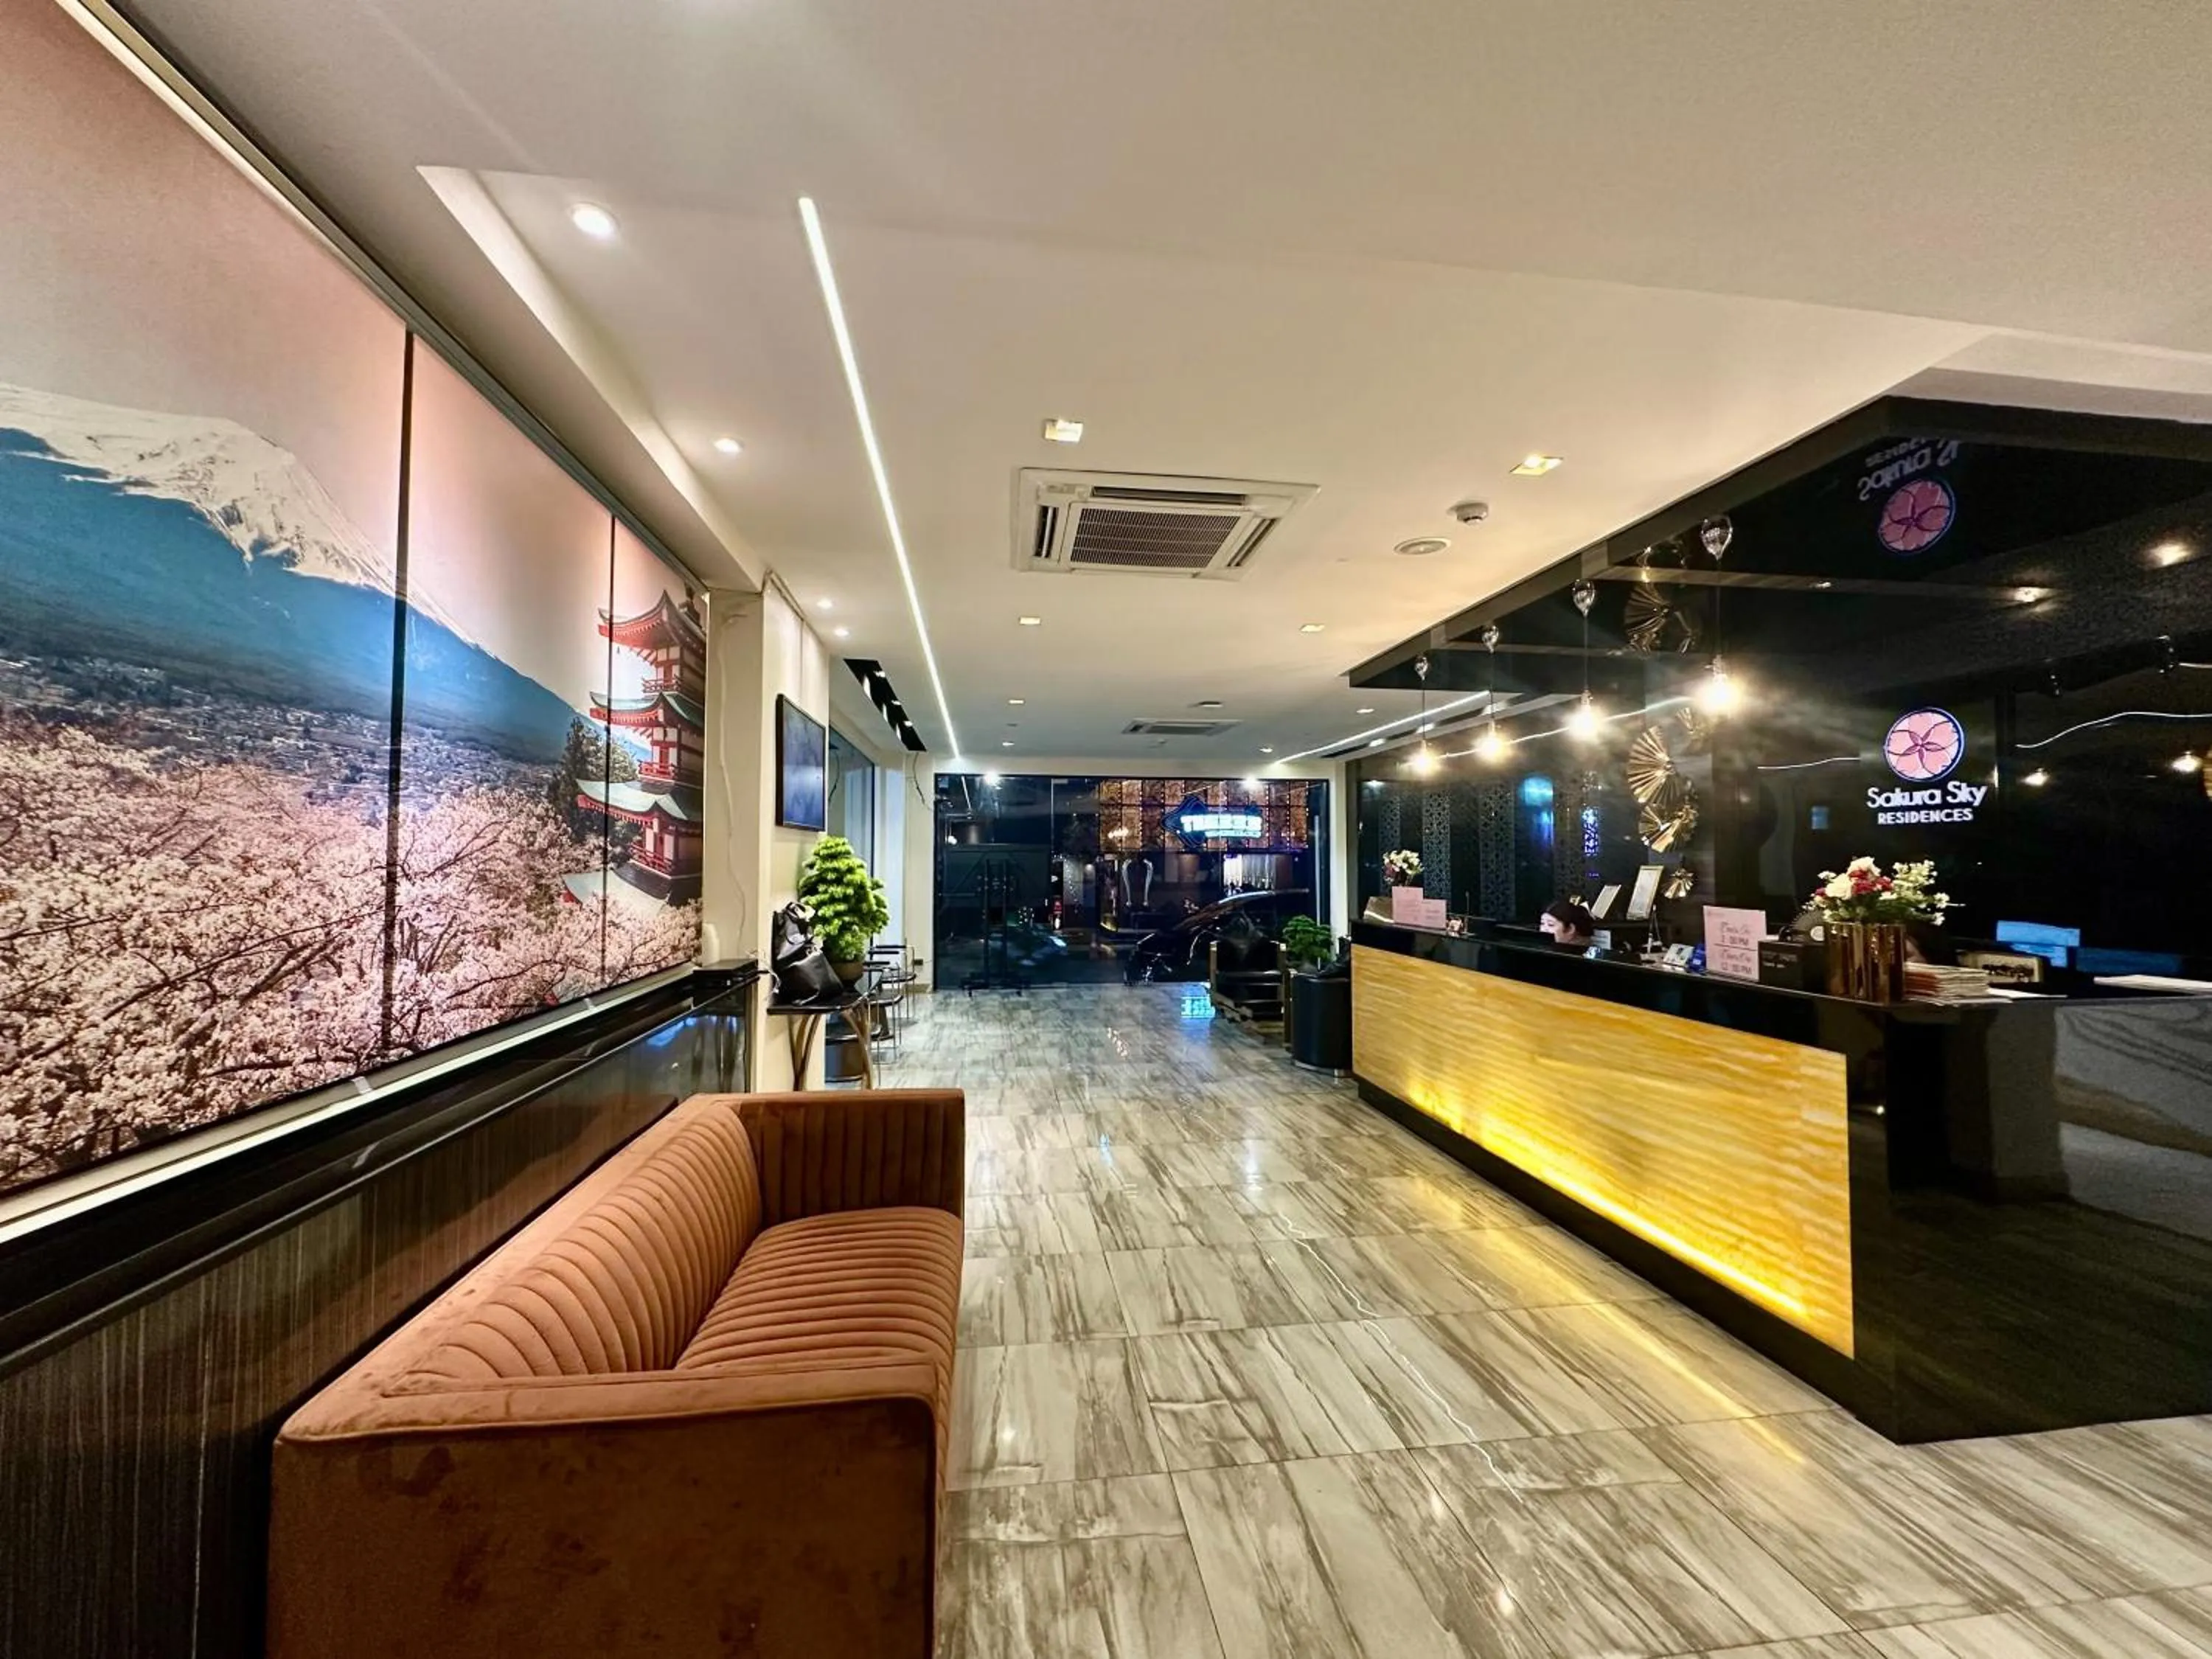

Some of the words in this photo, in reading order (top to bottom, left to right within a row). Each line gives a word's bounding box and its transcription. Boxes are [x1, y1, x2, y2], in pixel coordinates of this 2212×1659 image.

[1866, 787, 1942, 808] Sakura
[1946, 781, 1988, 806] Sky
[1877, 808, 1973, 825] RESIDENCES
